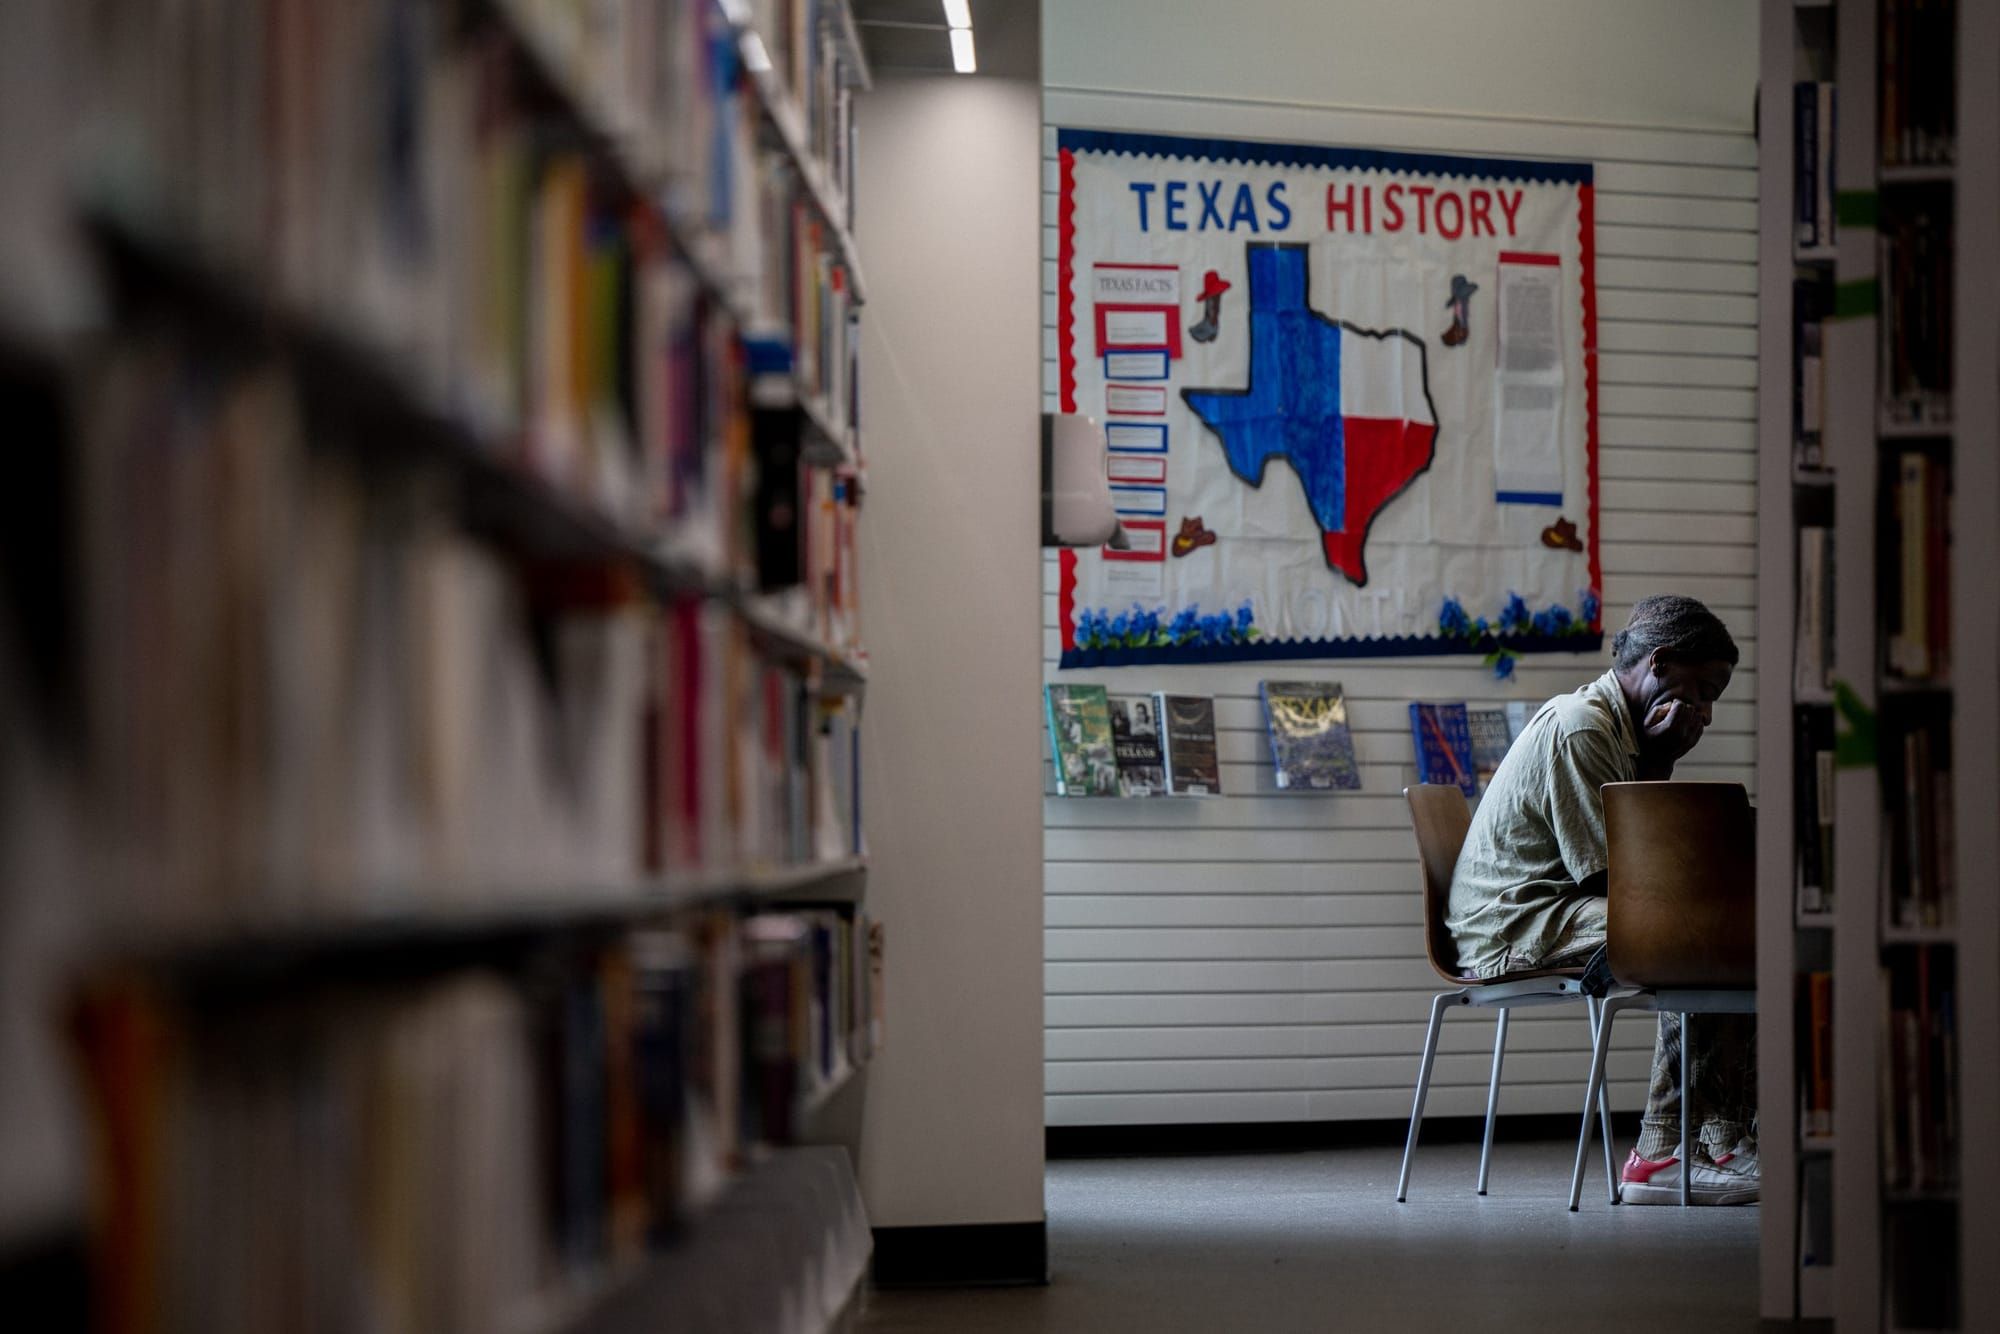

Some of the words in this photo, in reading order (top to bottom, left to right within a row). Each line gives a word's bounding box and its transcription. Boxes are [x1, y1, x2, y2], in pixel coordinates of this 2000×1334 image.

[1129, 180, 1292, 233] TEXAS
[1326, 182, 1524, 241] HISTORY
[1099, 277, 1133, 292] TEXAS
[1136, 278, 1173, 294] FACTS
